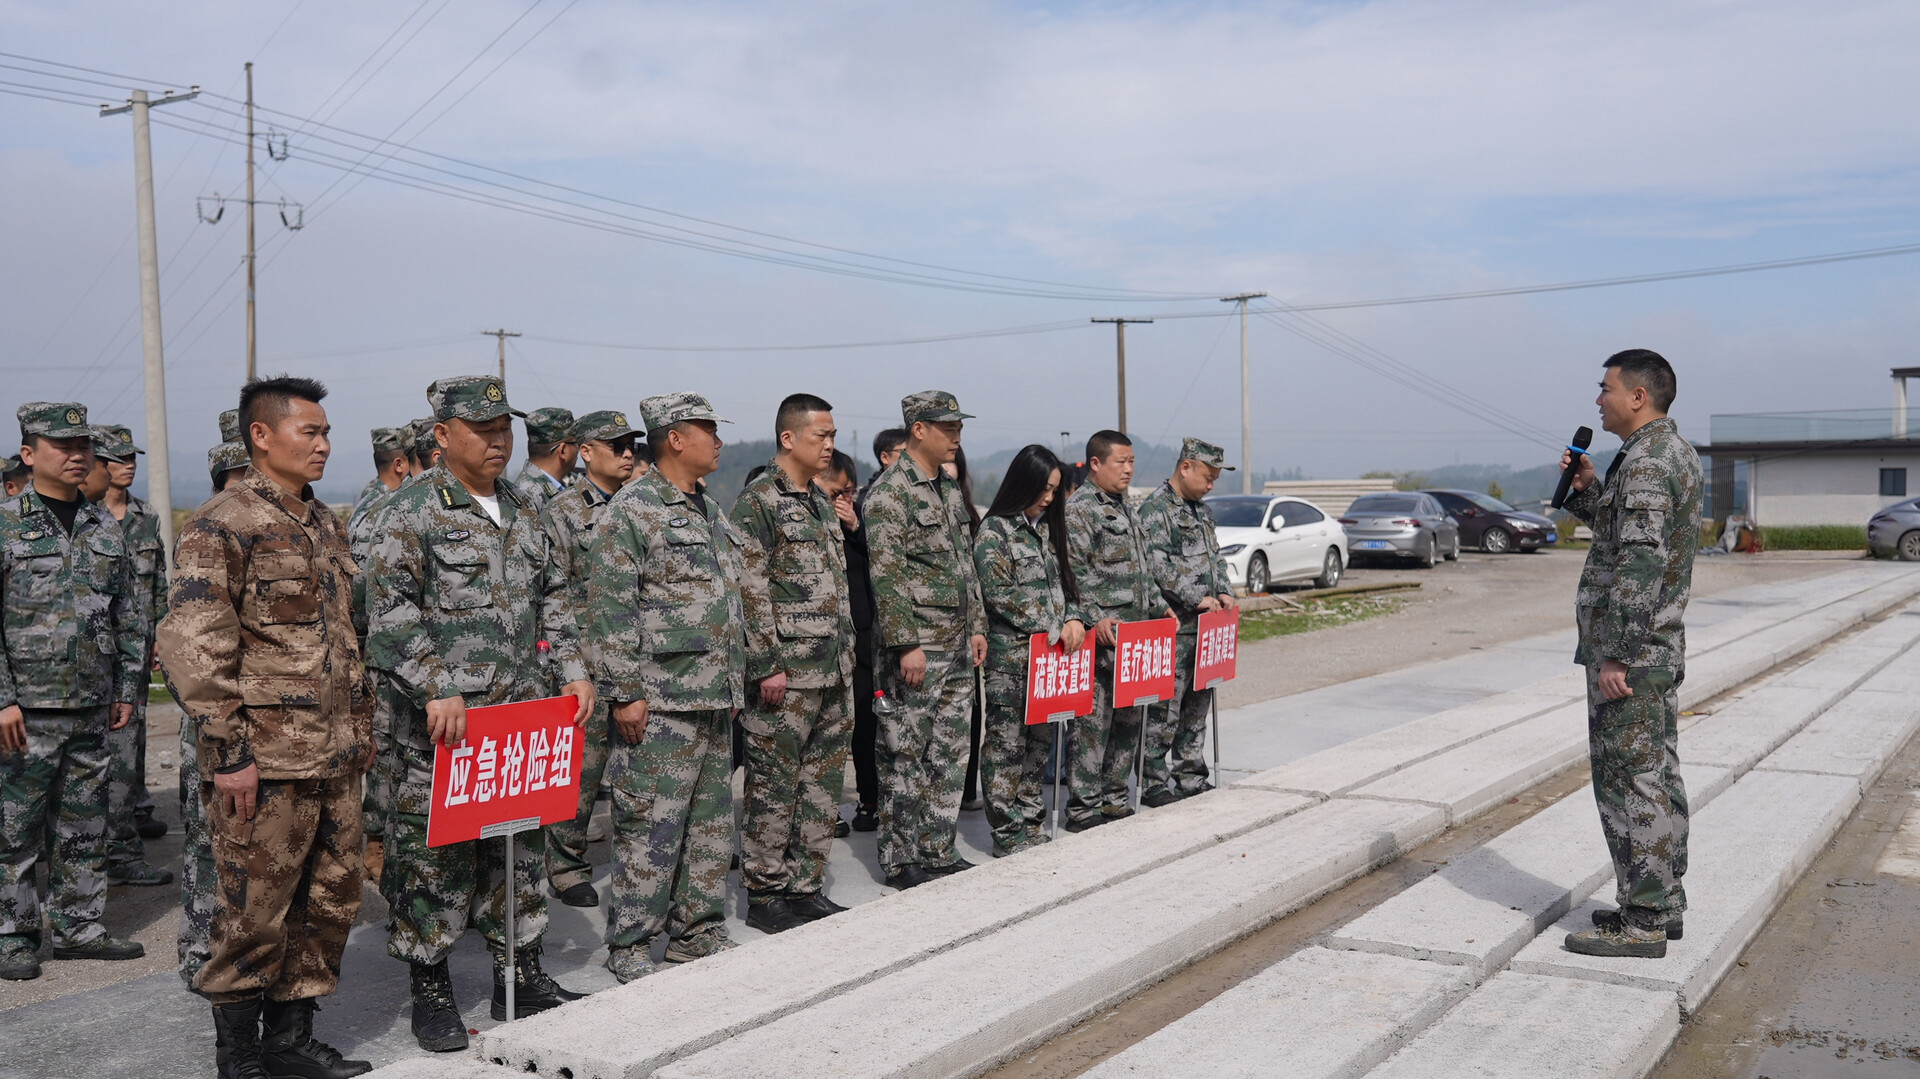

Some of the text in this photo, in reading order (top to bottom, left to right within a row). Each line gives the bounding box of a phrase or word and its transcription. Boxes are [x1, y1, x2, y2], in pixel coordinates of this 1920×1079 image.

[1120, 636, 1172, 683] 医疗救助组
[1200, 624, 1236, 669] 后勤保障组
[1034, 649, 1091, 699] 疏散安置组
[444, 726, 574, 809] 应急抢险组
